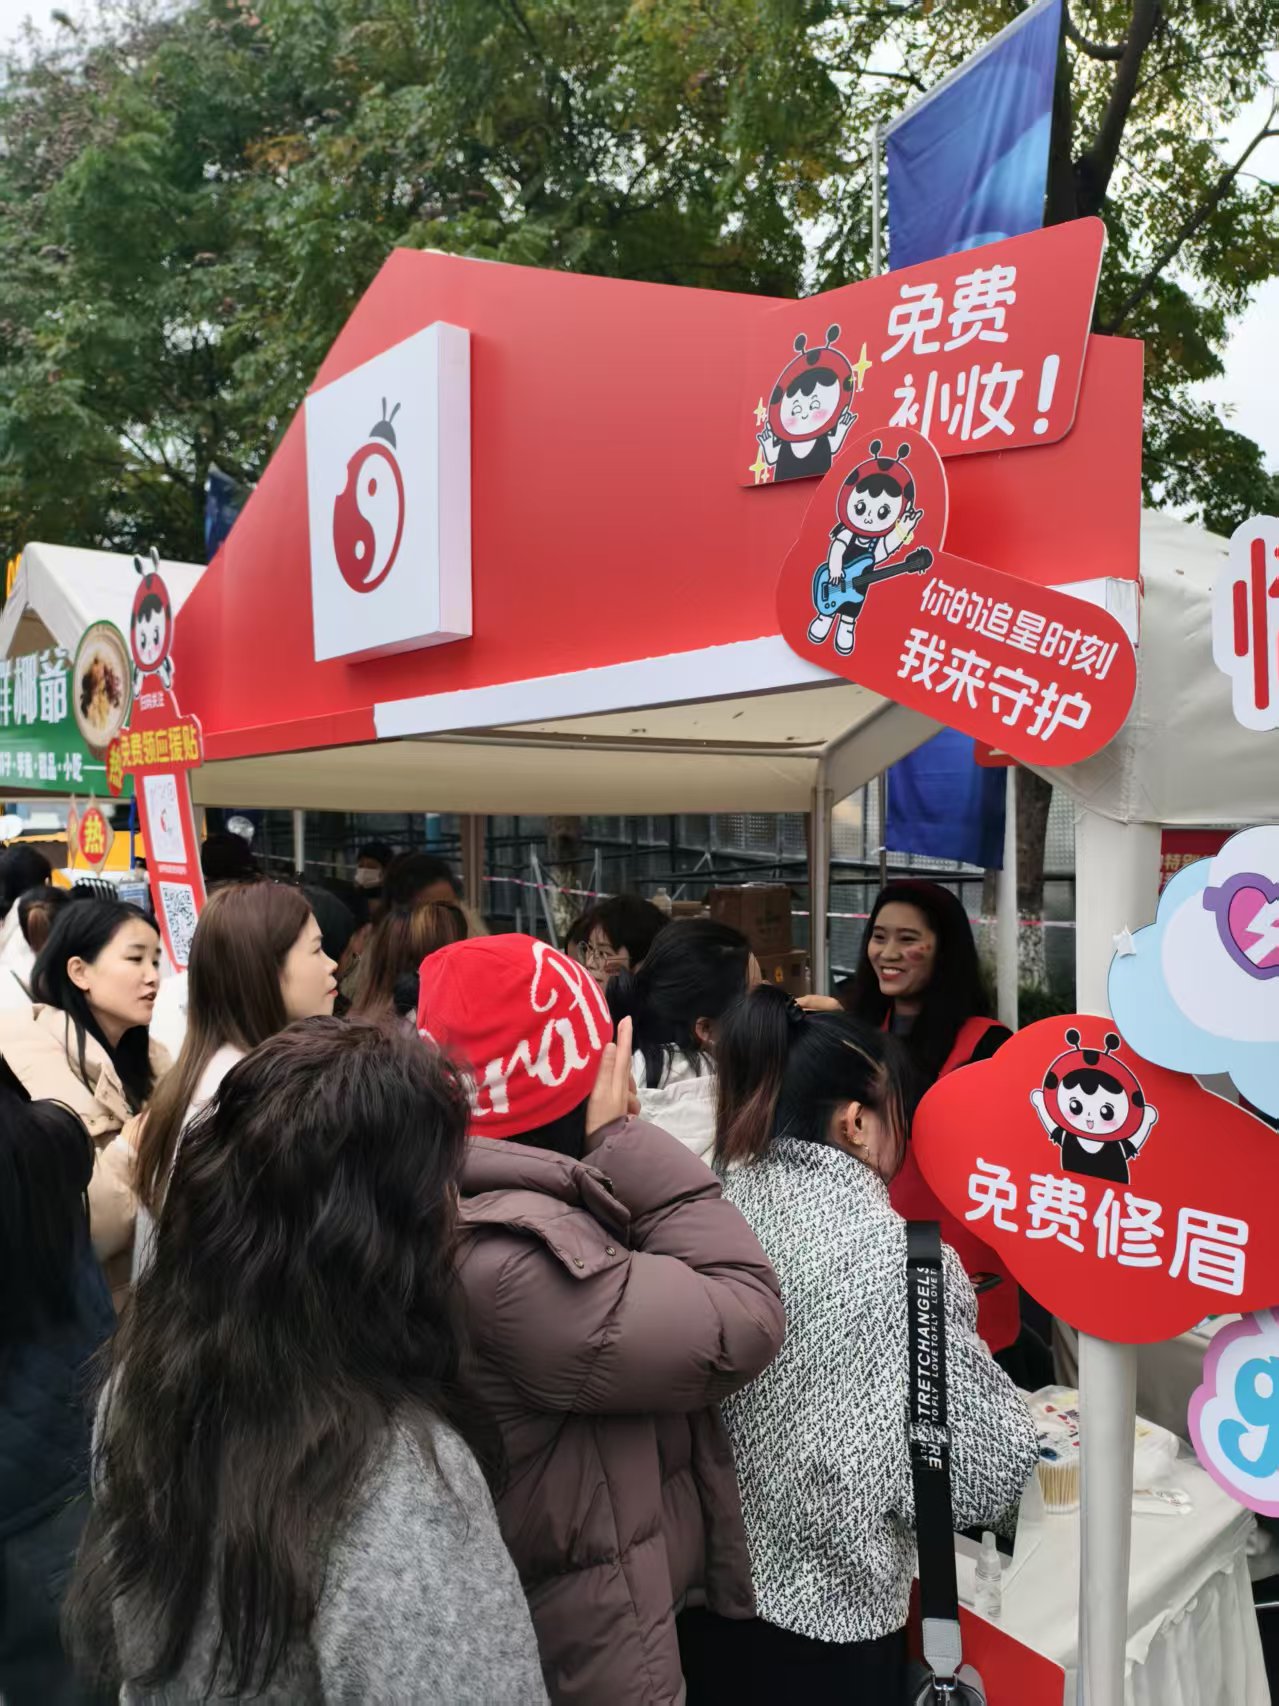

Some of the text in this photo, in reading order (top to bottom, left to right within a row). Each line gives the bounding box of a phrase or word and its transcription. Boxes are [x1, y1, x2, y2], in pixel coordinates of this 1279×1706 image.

[880, 264, 1018, 363] 免费
[920, 577, 1120, 681] 你的追星时刻
[896, 628, 1093, 742] 我来守护
[84, 814, 105, 854] 热
[964, 1157, 1250, 1297] 免费修眉
[931, 1276, 939, 1304] LOVE
[931, 1350, 939, 1377] LOVE
